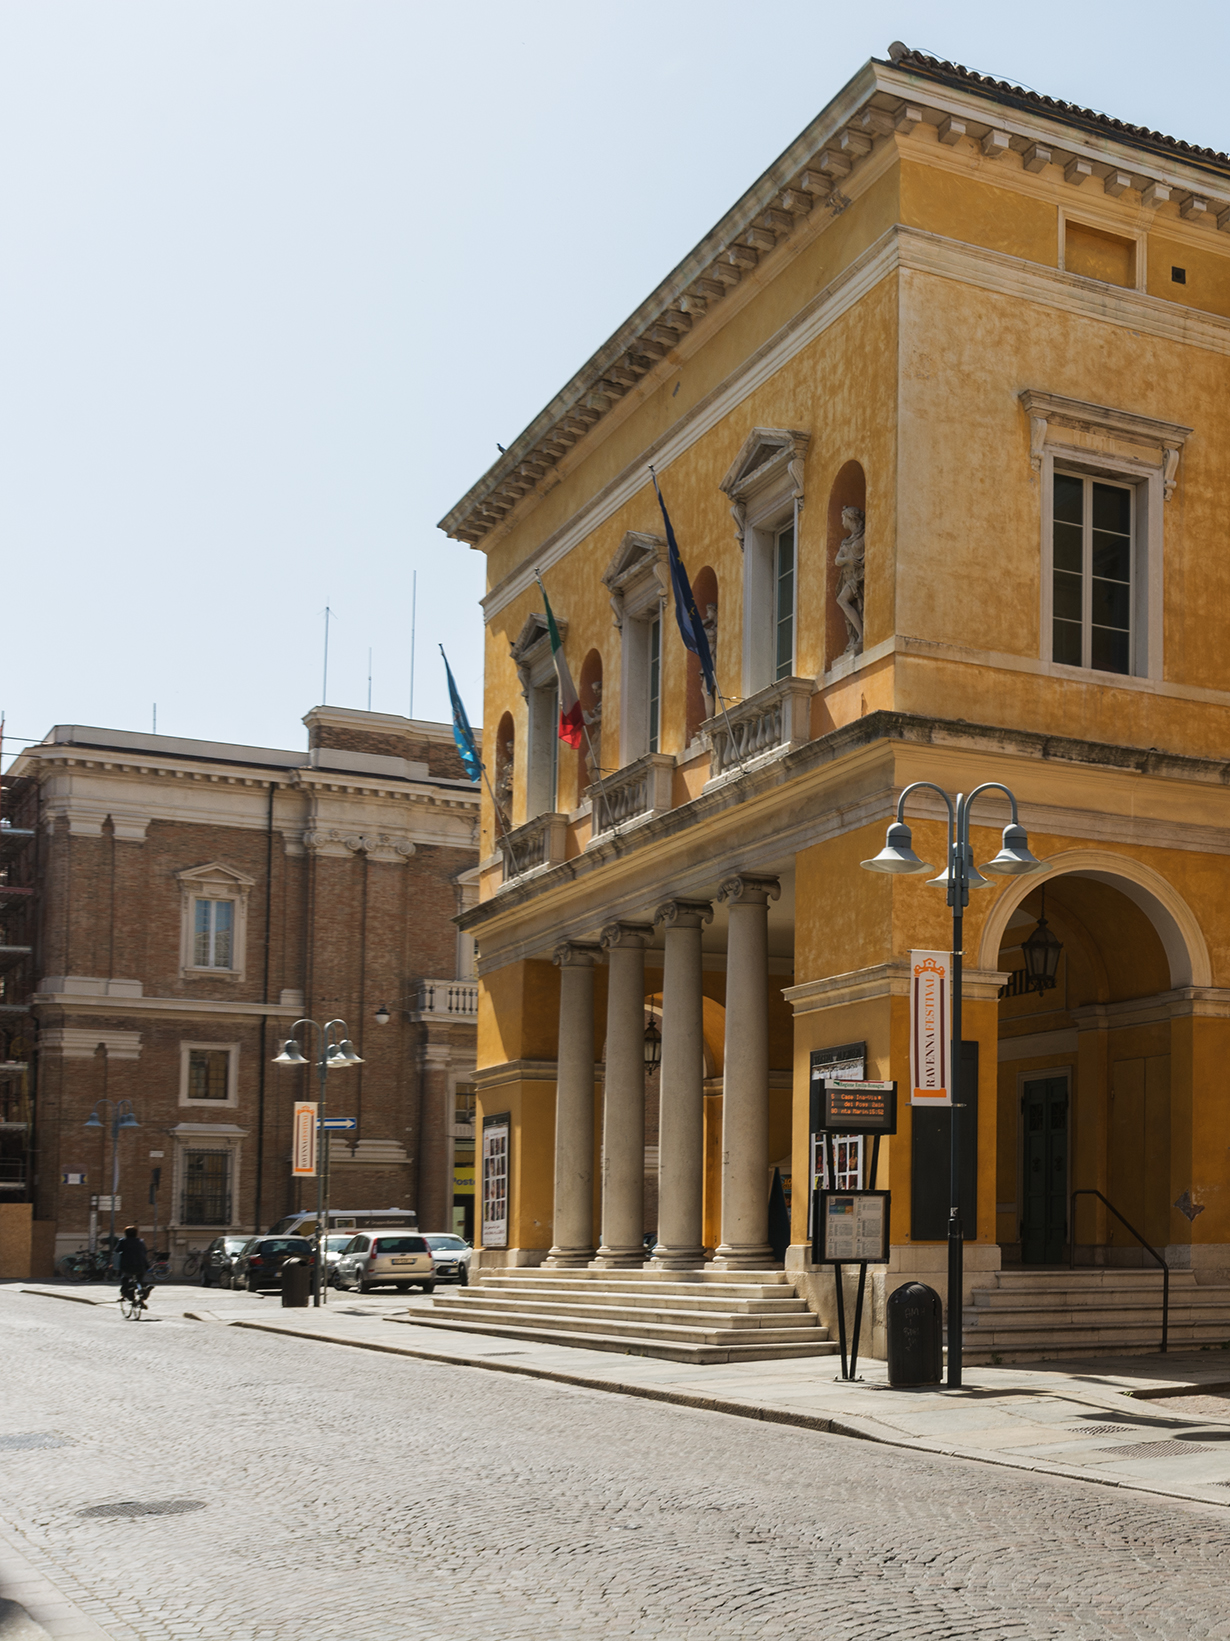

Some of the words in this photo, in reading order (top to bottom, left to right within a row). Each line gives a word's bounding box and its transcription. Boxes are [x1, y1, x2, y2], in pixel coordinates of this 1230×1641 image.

[925, 975, 935, 1032] FESTIVAL
[925, 1033, 935, 1088] RAVENNA
[453, 1177, 475, 1186] ost
